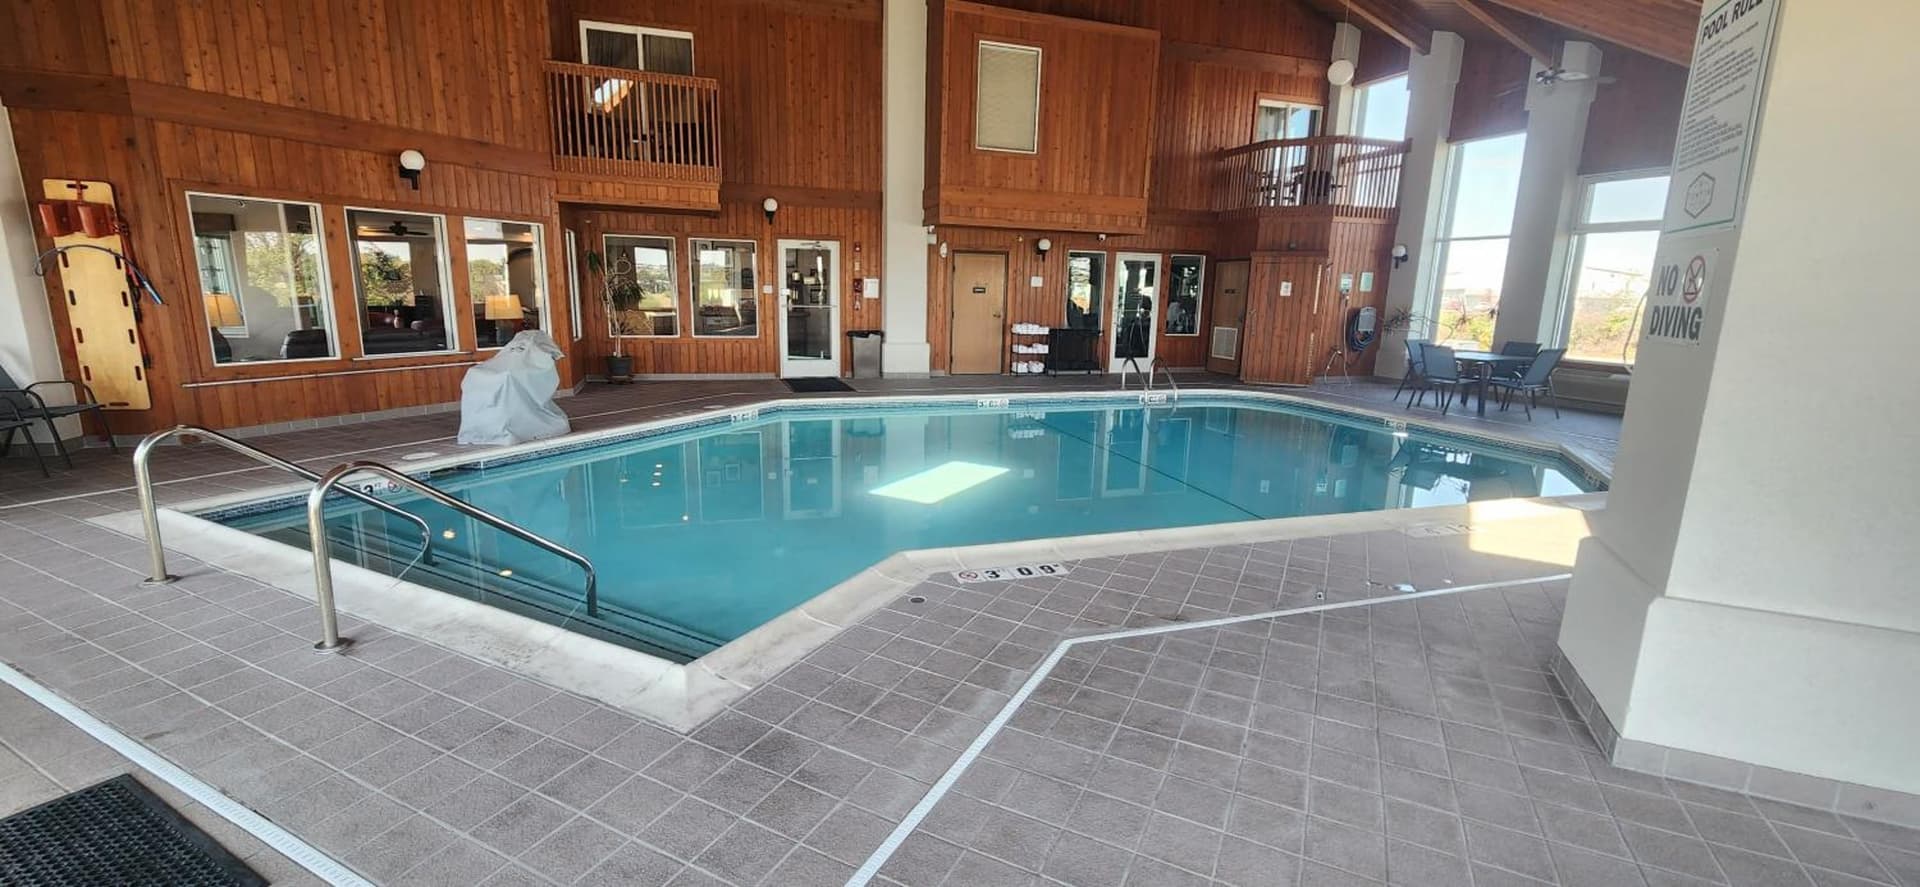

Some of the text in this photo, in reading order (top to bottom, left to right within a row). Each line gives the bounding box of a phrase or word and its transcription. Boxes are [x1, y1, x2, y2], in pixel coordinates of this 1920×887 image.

[1701, 10, 1728, 45] POOL
[1656, 264, 1680, 296] NO
[1649, 305, 1703, 341] DIVING
